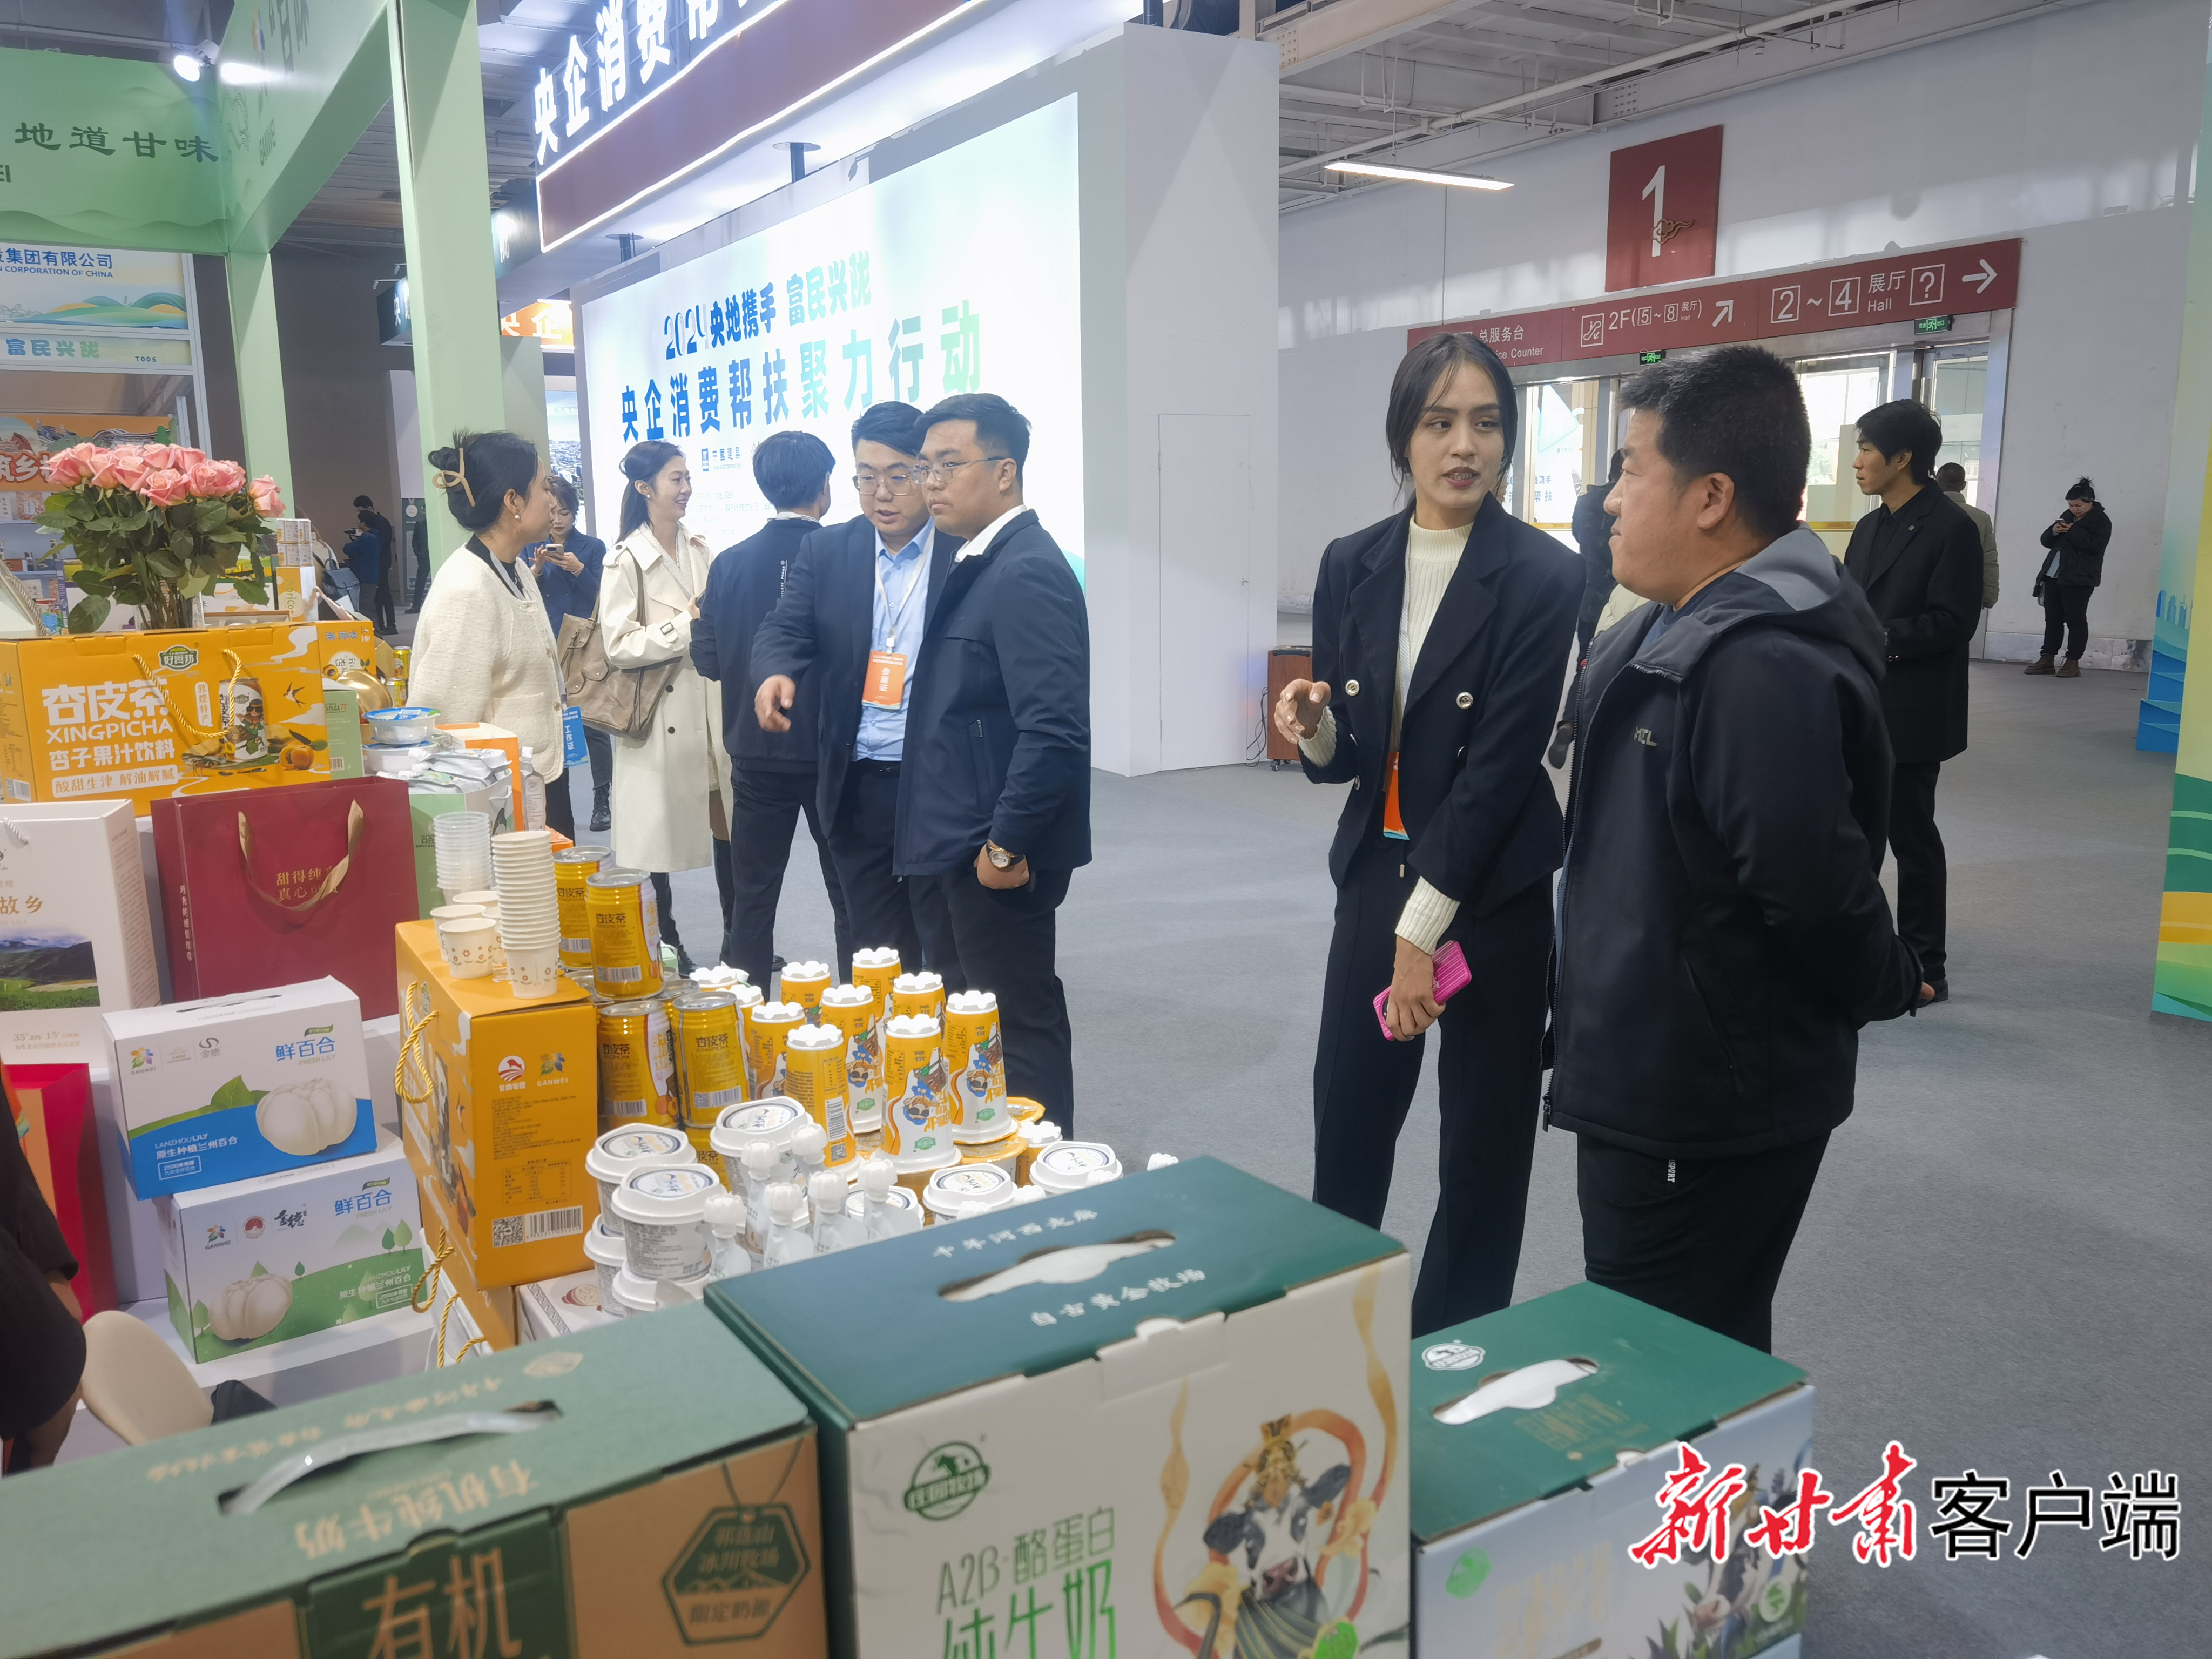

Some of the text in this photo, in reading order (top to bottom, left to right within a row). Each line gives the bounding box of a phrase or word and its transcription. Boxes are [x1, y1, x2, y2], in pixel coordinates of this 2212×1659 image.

[15, 122, 219, 163] 地道甘味
[1642, 165, 1665, 257] 1
[5, 265, 70, 276] CORPORATION
[85, 270, 113, 278] CHINA
[786, 250, 872, 326] 富民兴陇
[1868, 298, 1892, 312] Hall
[1479, 325, 1524, 344] 总服务台
[6, 338, 100, 359] 富民兴陇
[1510, 346, 1544, 359] Counter
[621, 300, 981, 443] 央企消费帮扶聚力行动
[41, 678, 169, 727] 杏皮茶
[197, 683, 209, 724] 敦煌特产
[46, 719, 174, 744] XINGPICHA
[49, 739, 176, 771] 杏子果汁饮料
[55, 767, 176, 794] 酸甜生津 解油解腻
[276, 866, 332, 886] 甜得纯
[0, 895, 43, 915] 故乡
[275, 1036, 335, 1062] 鲜百合
[299, 1056, 321, 1066] FRESH
[131, 1067, 156, 1075] GANWEI
[537, 1077, 568, 1087] GANWEI
[335, 1189, 392, 1217] 鲜百合
[294, 1459, 539, 1559] 有机纯牛奶
[363, 1548, 522, 1659] 有机
